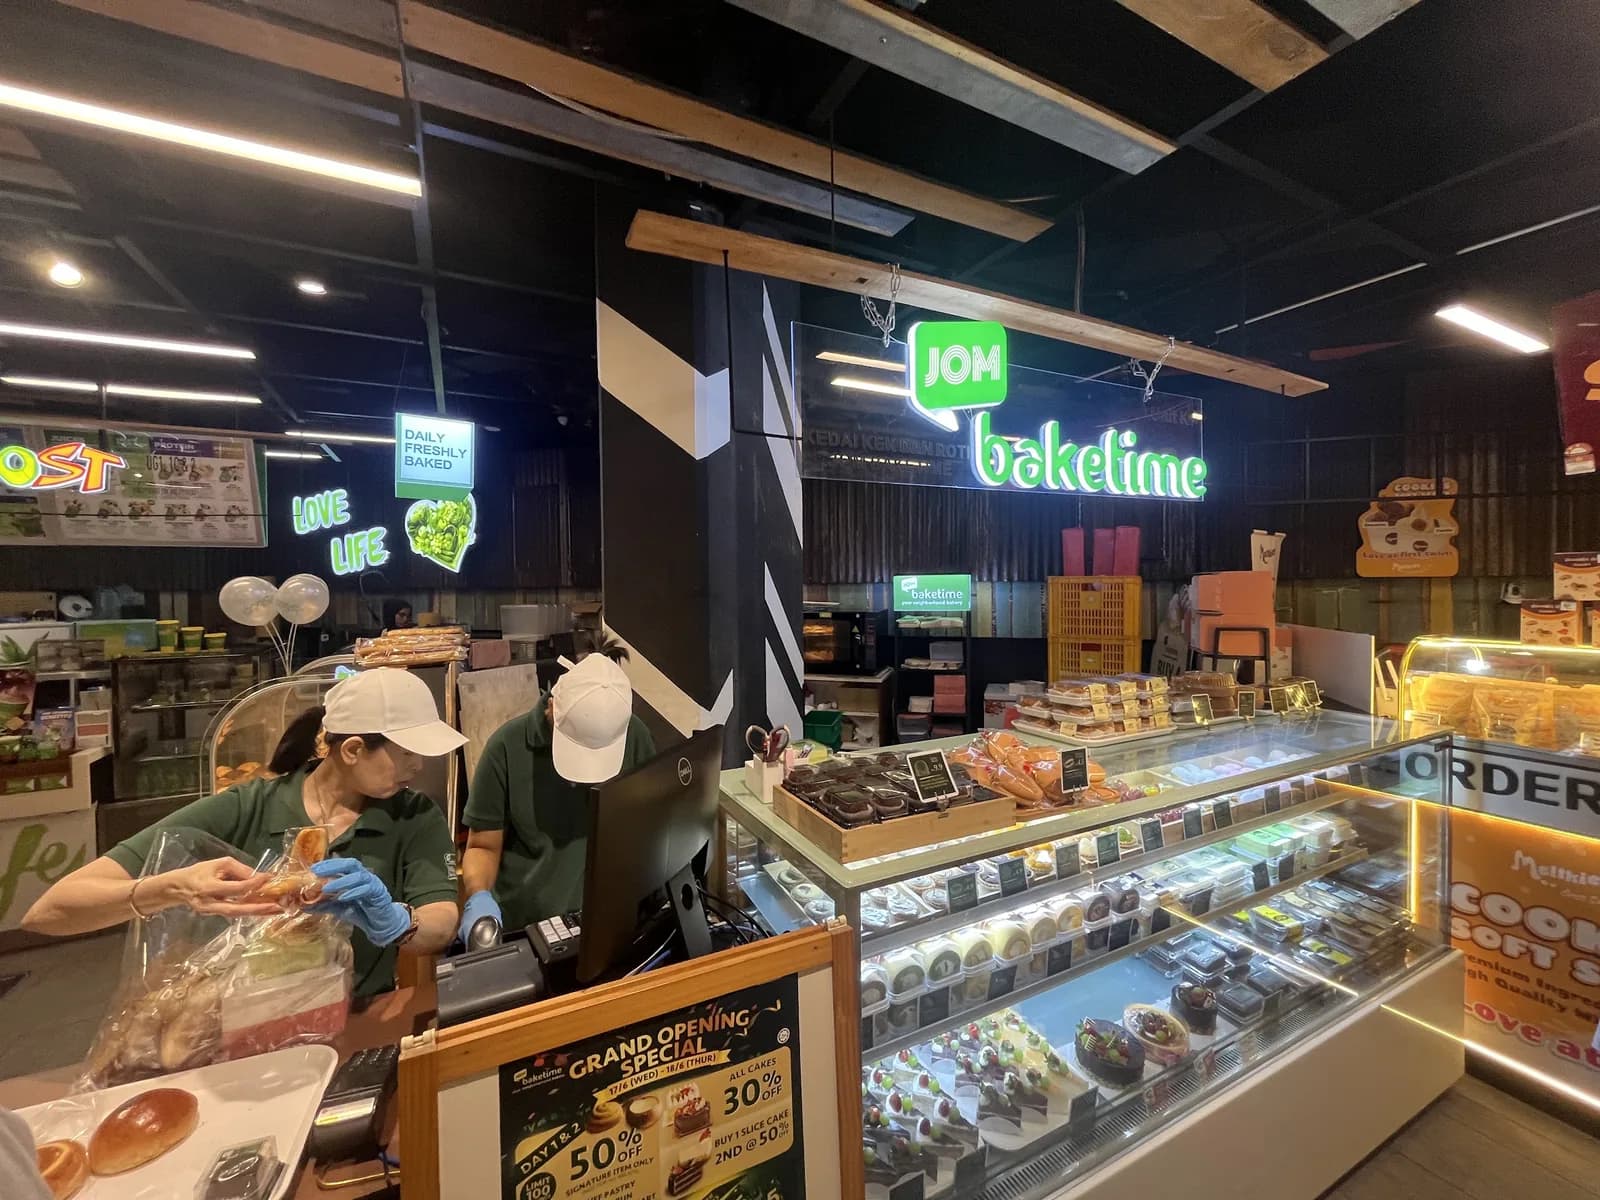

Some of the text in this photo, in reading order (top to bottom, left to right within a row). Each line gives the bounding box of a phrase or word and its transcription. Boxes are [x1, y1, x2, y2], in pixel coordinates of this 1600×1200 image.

[924, 345, 1000, 387] JOM
[405, 429, 445, 443] DAILY
[405, 443, 467, 459] FRESHLY
[973, 411, 1208, 498] baketime
[404, 456, 452, 470] BAKED
[293, 490, 349, 533] LOVE
[331, 528, 388, 574] LIFE
[911, 588, 963, 599] baketime
[1450, 916, 1558, 970] SOFT
[1495, 976, 1566, 1013] Quality
[1464, 1002, 1543, 1044] ove
[569, 1009, 750, 1079] GRAND OPENING
[620, 1037, 706, 1078] SPECIAL
[630, 1070, 659, 1088] (WED)
[686, 1053, 716, 1069] (THUR)
[730, 1057, 777, 1081] ALL CAKES
[762, 1085, 782, 1101] OFF
[714, 1134, 733, 1148] BUY
[741, 1120, 765, 1137] SLICE
[766, 1109, 789, 1125] CAKE
[520, 1147, 549, 1174] DAY
[559, 1132, 571, 1144] &
[571, 1122, 581, 1133] 2
[618, 1145, 643, 1163] OFF
[715, 1145, 742, 1165] 2ND
[746, 1138, 757, 1151] @
[525, 1176, 550, 1192] LIMIT
[566, 1169, 612, 1196] SIGNATURE
[613, 1164, 632, 1176] ITEM
[633, 1157, 655, 1169] ONLY
[604, 1180, 635, 1197] PASTRY
